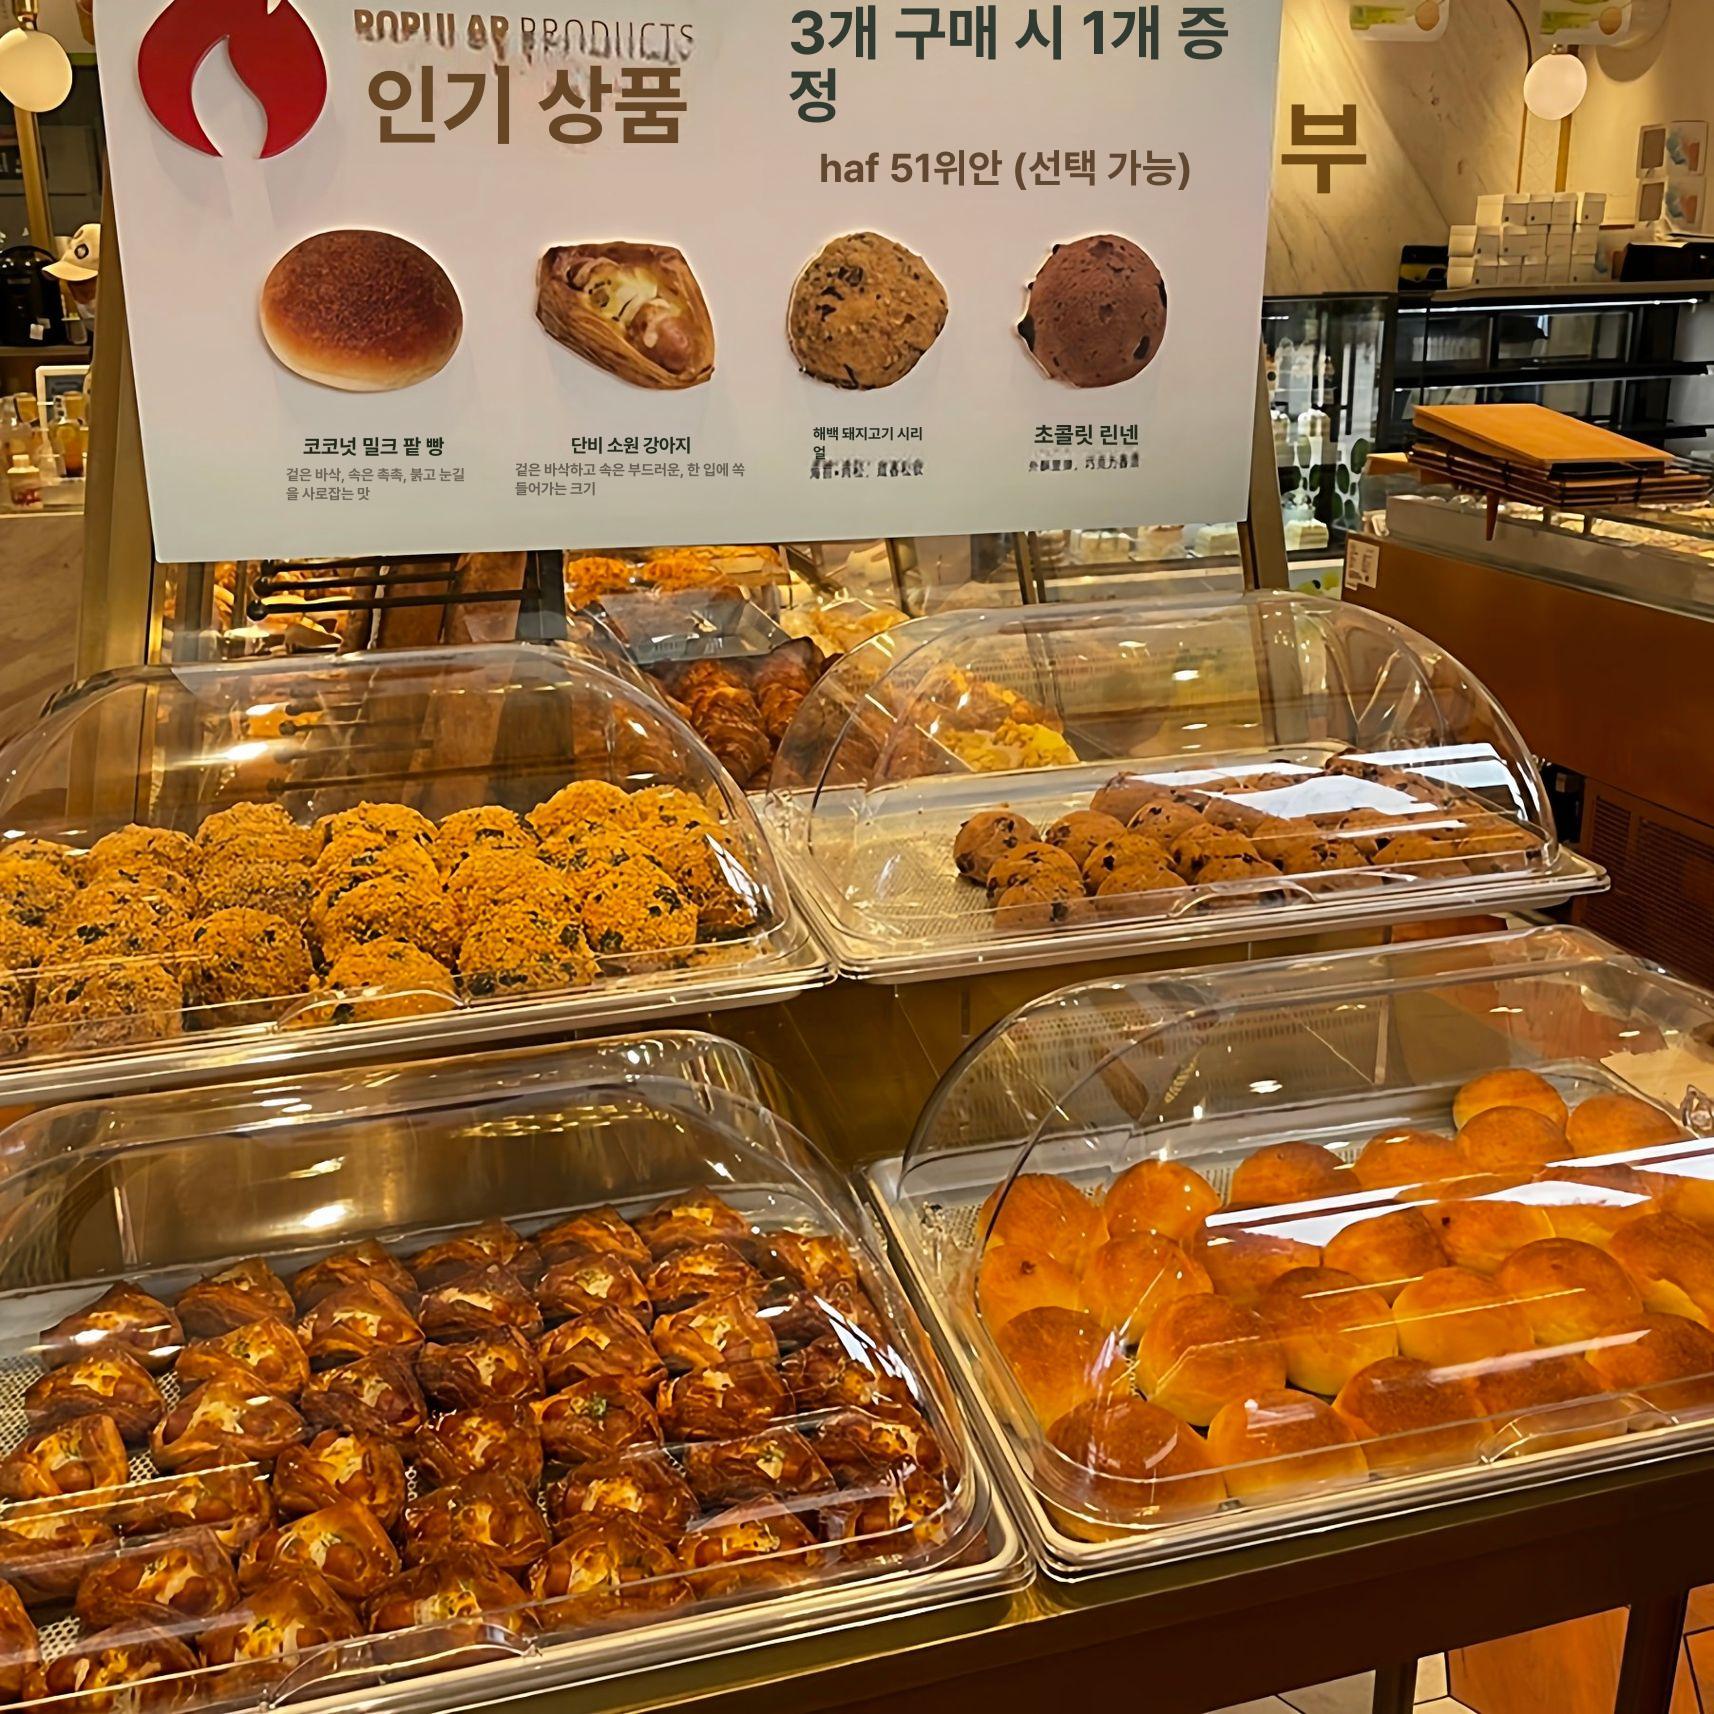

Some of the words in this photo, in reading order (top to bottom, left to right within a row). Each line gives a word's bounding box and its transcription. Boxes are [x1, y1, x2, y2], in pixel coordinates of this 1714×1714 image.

[791, 5, 875, 60] 3개
[895, 5, 996, 60] 구매
[1015, 5, 1061, 60] 시
[1084, 5, 1159, 60] 1개
[1177, 7, 1229, 60] 증
[368, 65, 510, 145] 인기
[537, 65, 688, 145] 상품
[790, 68, 835, 123] 정
[1281, 104, 1367, 194] 부
[821, 152, 879, 182] haf
[891, 150, 1002, 186] 51위안
[1015, 150, 1095, 190] (선택
[1108, 150, 1189, 190] 가능)
[813, 427, 838, 440] 해백
[842, 427, 893, 440] 돼지고기
[897, 427, 922, 440] 시리
[1034, 424, 1092, 445] 초콜릿
[1101, 425, 1138, 445] 린넨
[303, 437, 356, 456] 코코넛
[363, 437, 398, 456] 밀크
[403, 437, 421, 456] 팥
[427, 437, 444, 456] 빵
[572, 437, 602, 454] 단비
[607, 437, 638, 454] 소원
[644, 437, 690, 454] 강아지
[348, 468, 374, 482] 속은
[377, 468, 406, 483] 촉촉,
[439, 468, 464, 481] 눈길
[545, 463, 596, 477] 바삭하고
[599, 463, 624, 476] 속은
[628, 463, 683, 478] 부드러운,
[687, 463, 700, 476] 한
[704, 463, 728, 477] 입에
[286, 487, 299, 500] 을
[302, 487, 354, 501] 사로잡는
[358, 487, 370, 500] 맛
[515, 482, 567, 496] 들어가는
[570, 482, 595, 496] 크기
